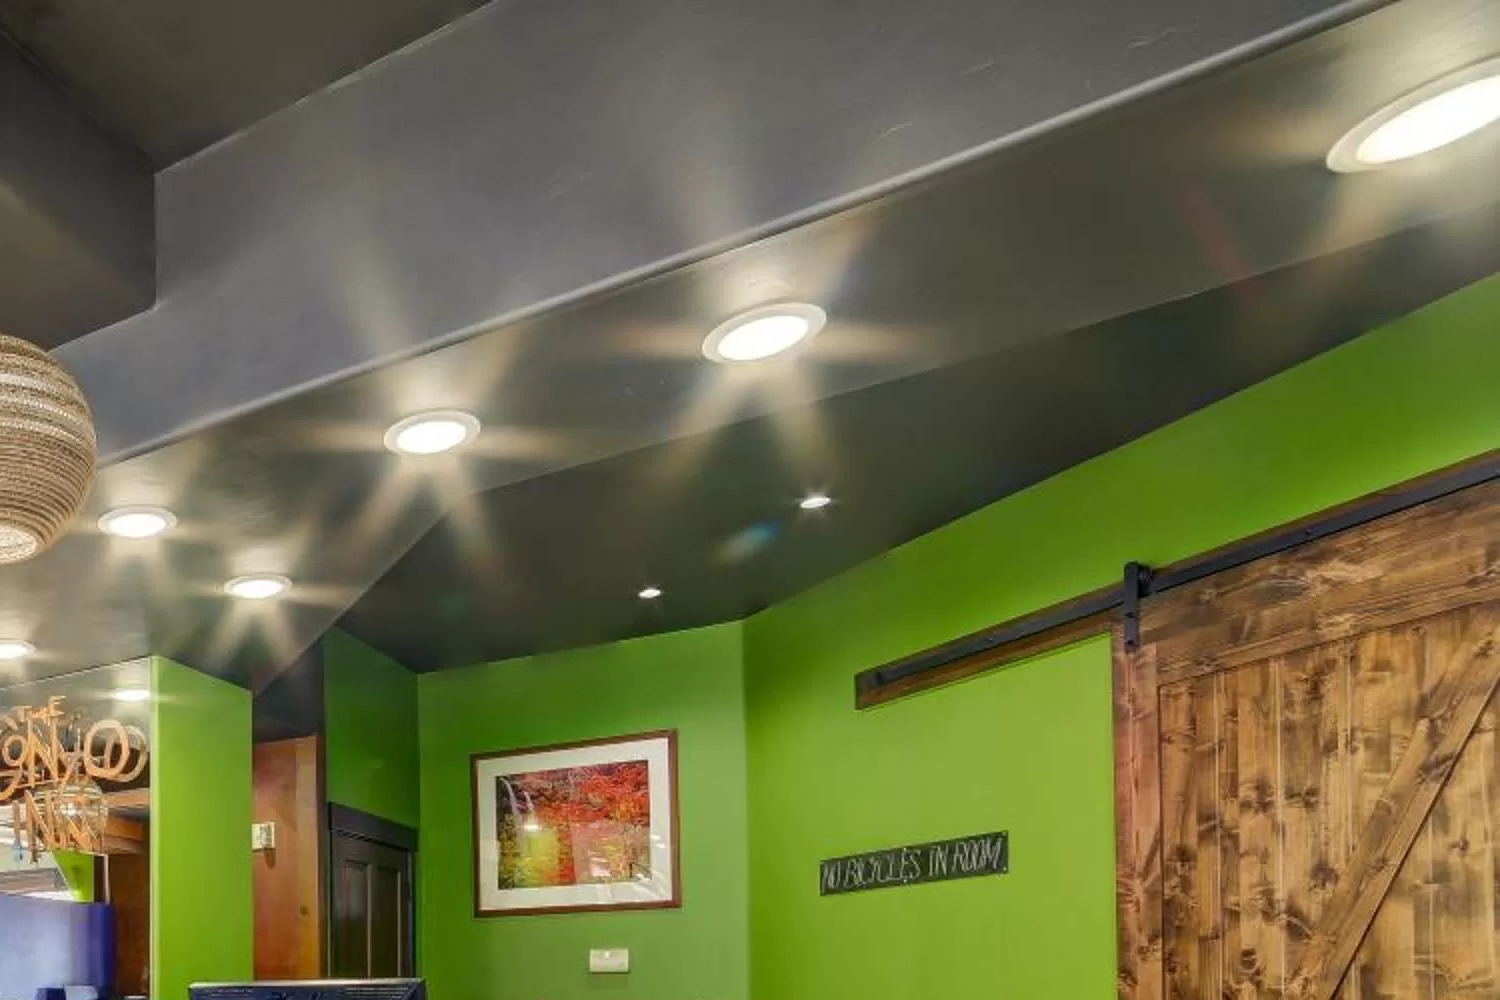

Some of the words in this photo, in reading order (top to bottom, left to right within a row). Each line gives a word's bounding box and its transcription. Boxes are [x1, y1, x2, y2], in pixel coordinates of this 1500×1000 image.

[843, 850, 922, 888] BICYCLES
[929, 845, 950, 877] IN
[952, 837, 1003, 873] ROOM
